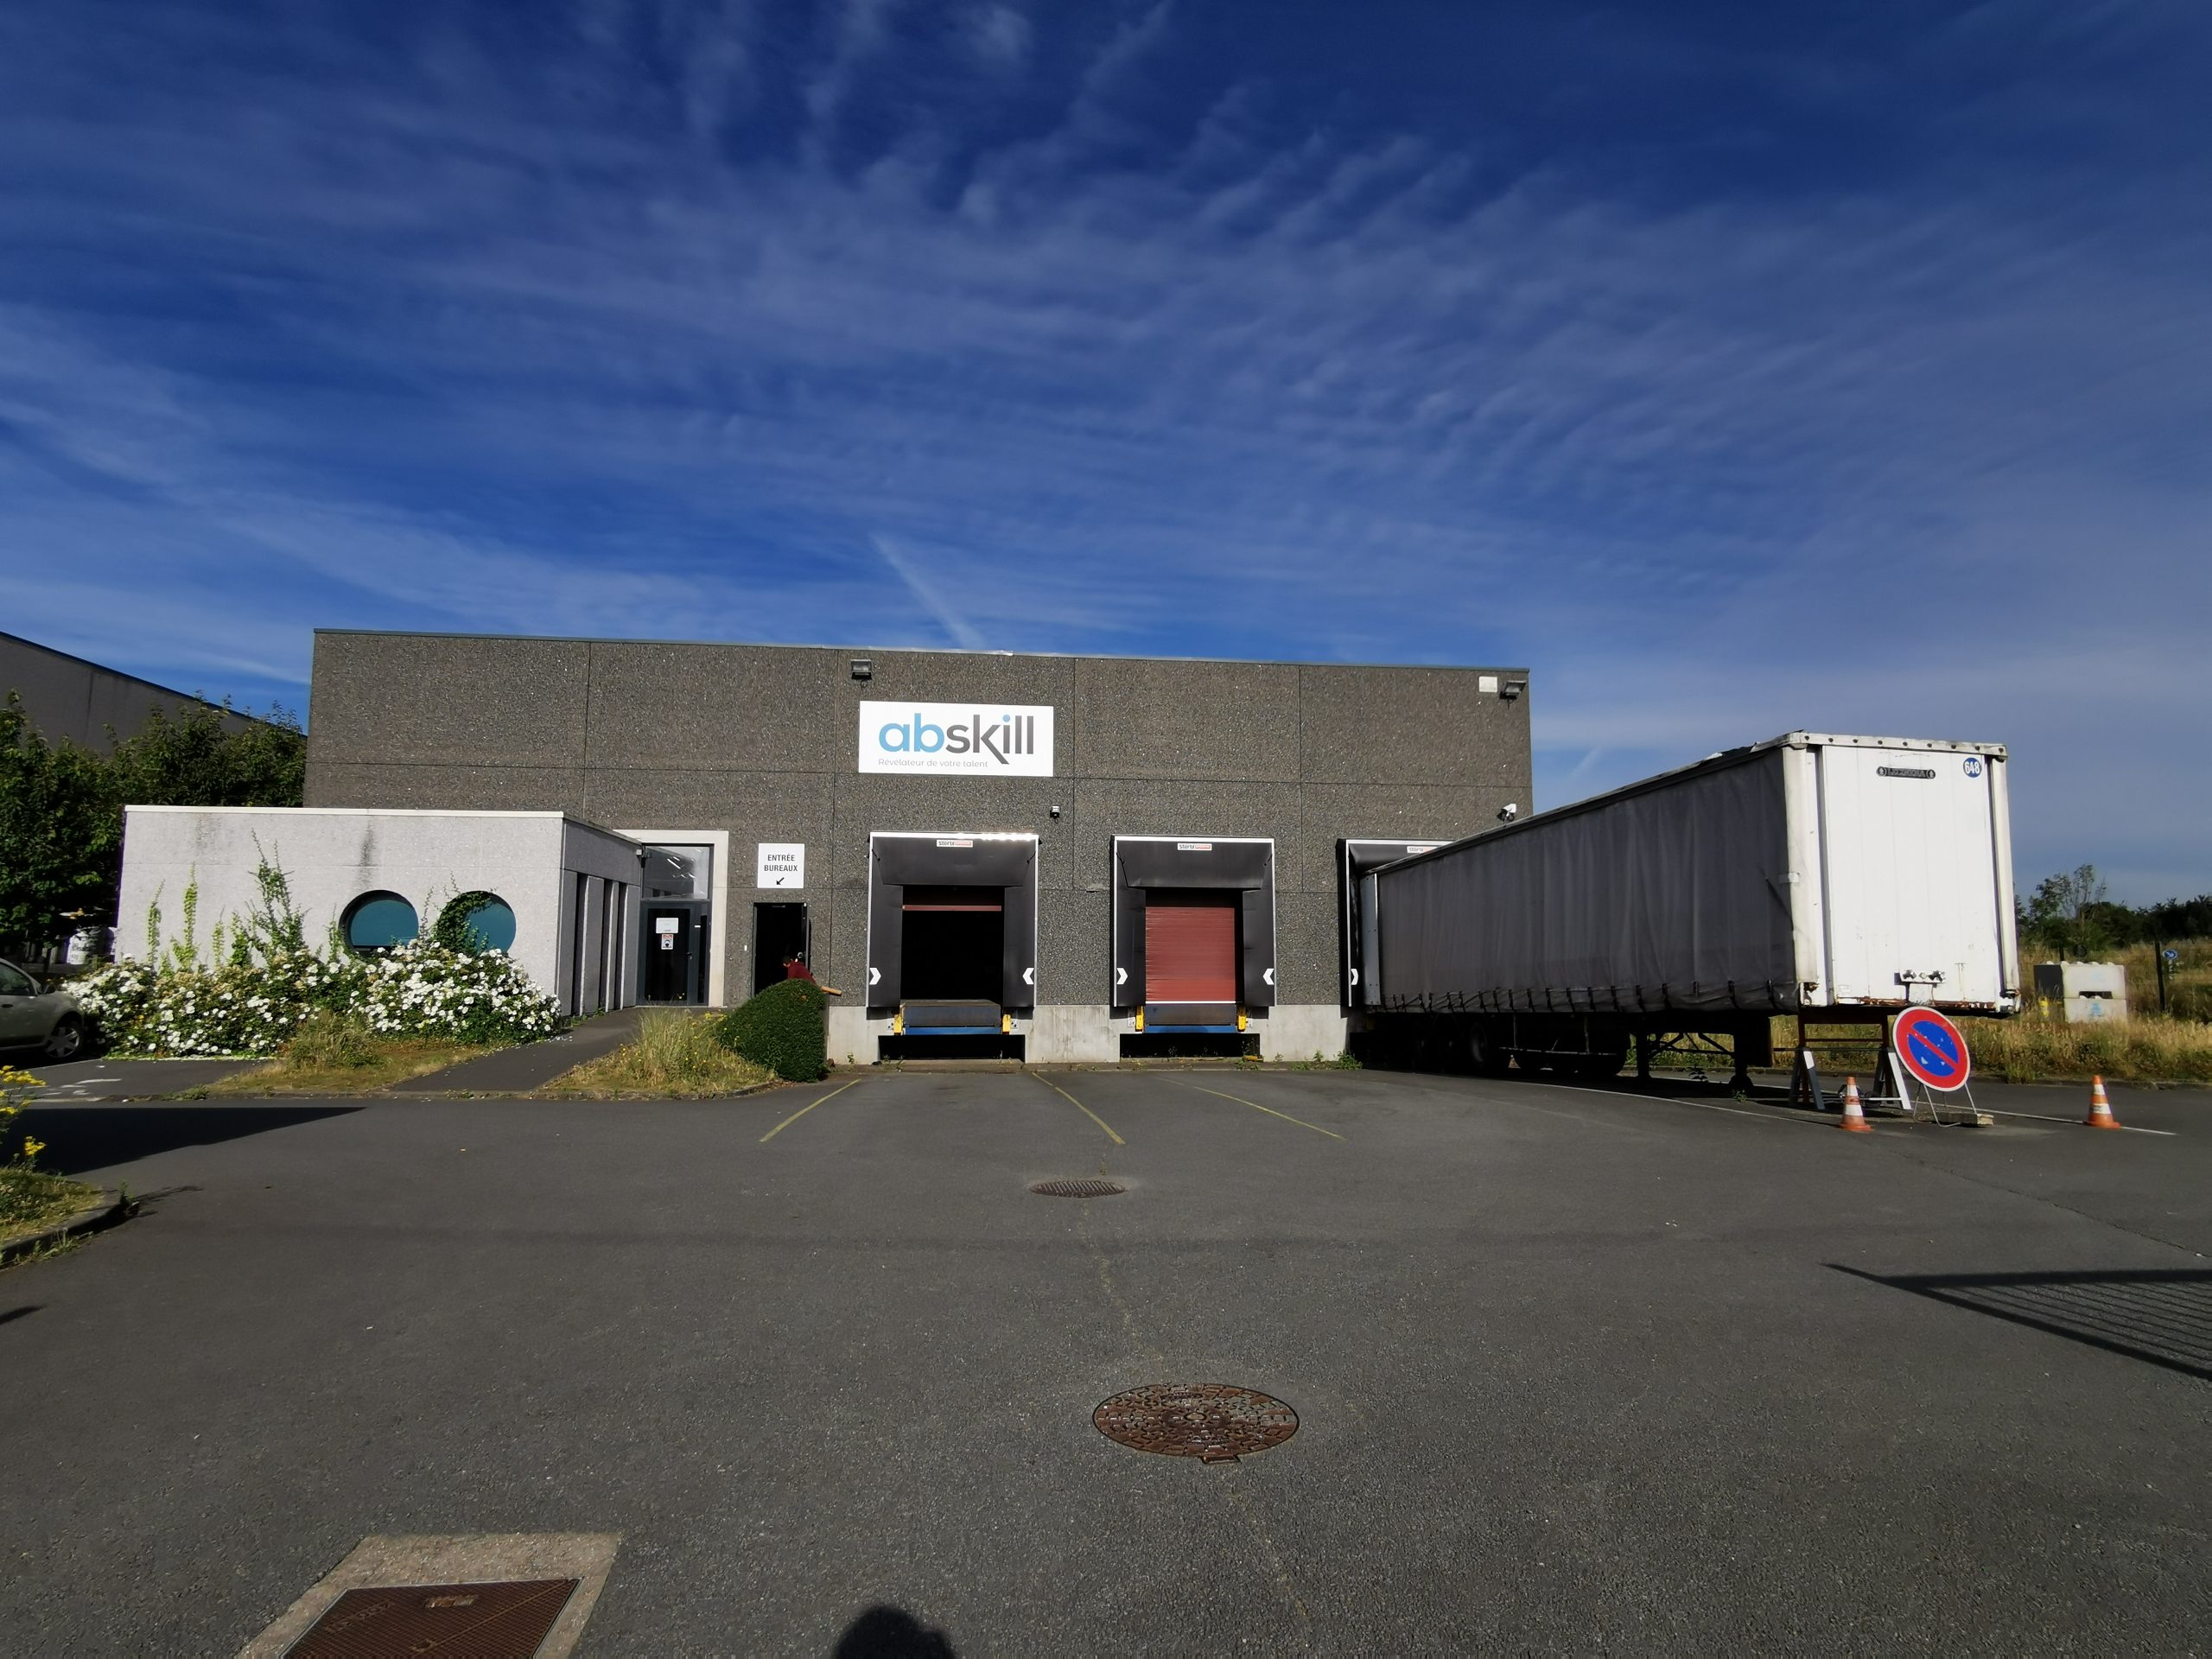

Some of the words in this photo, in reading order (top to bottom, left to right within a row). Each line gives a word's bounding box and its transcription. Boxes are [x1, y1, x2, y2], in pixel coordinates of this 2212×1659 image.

[879, 713, 1034, 765] abskill
[926, 759, 938, 767] de
[1964, 761, 1980, 774] 648
[767, 852, 796, 861] ENTRÉE
